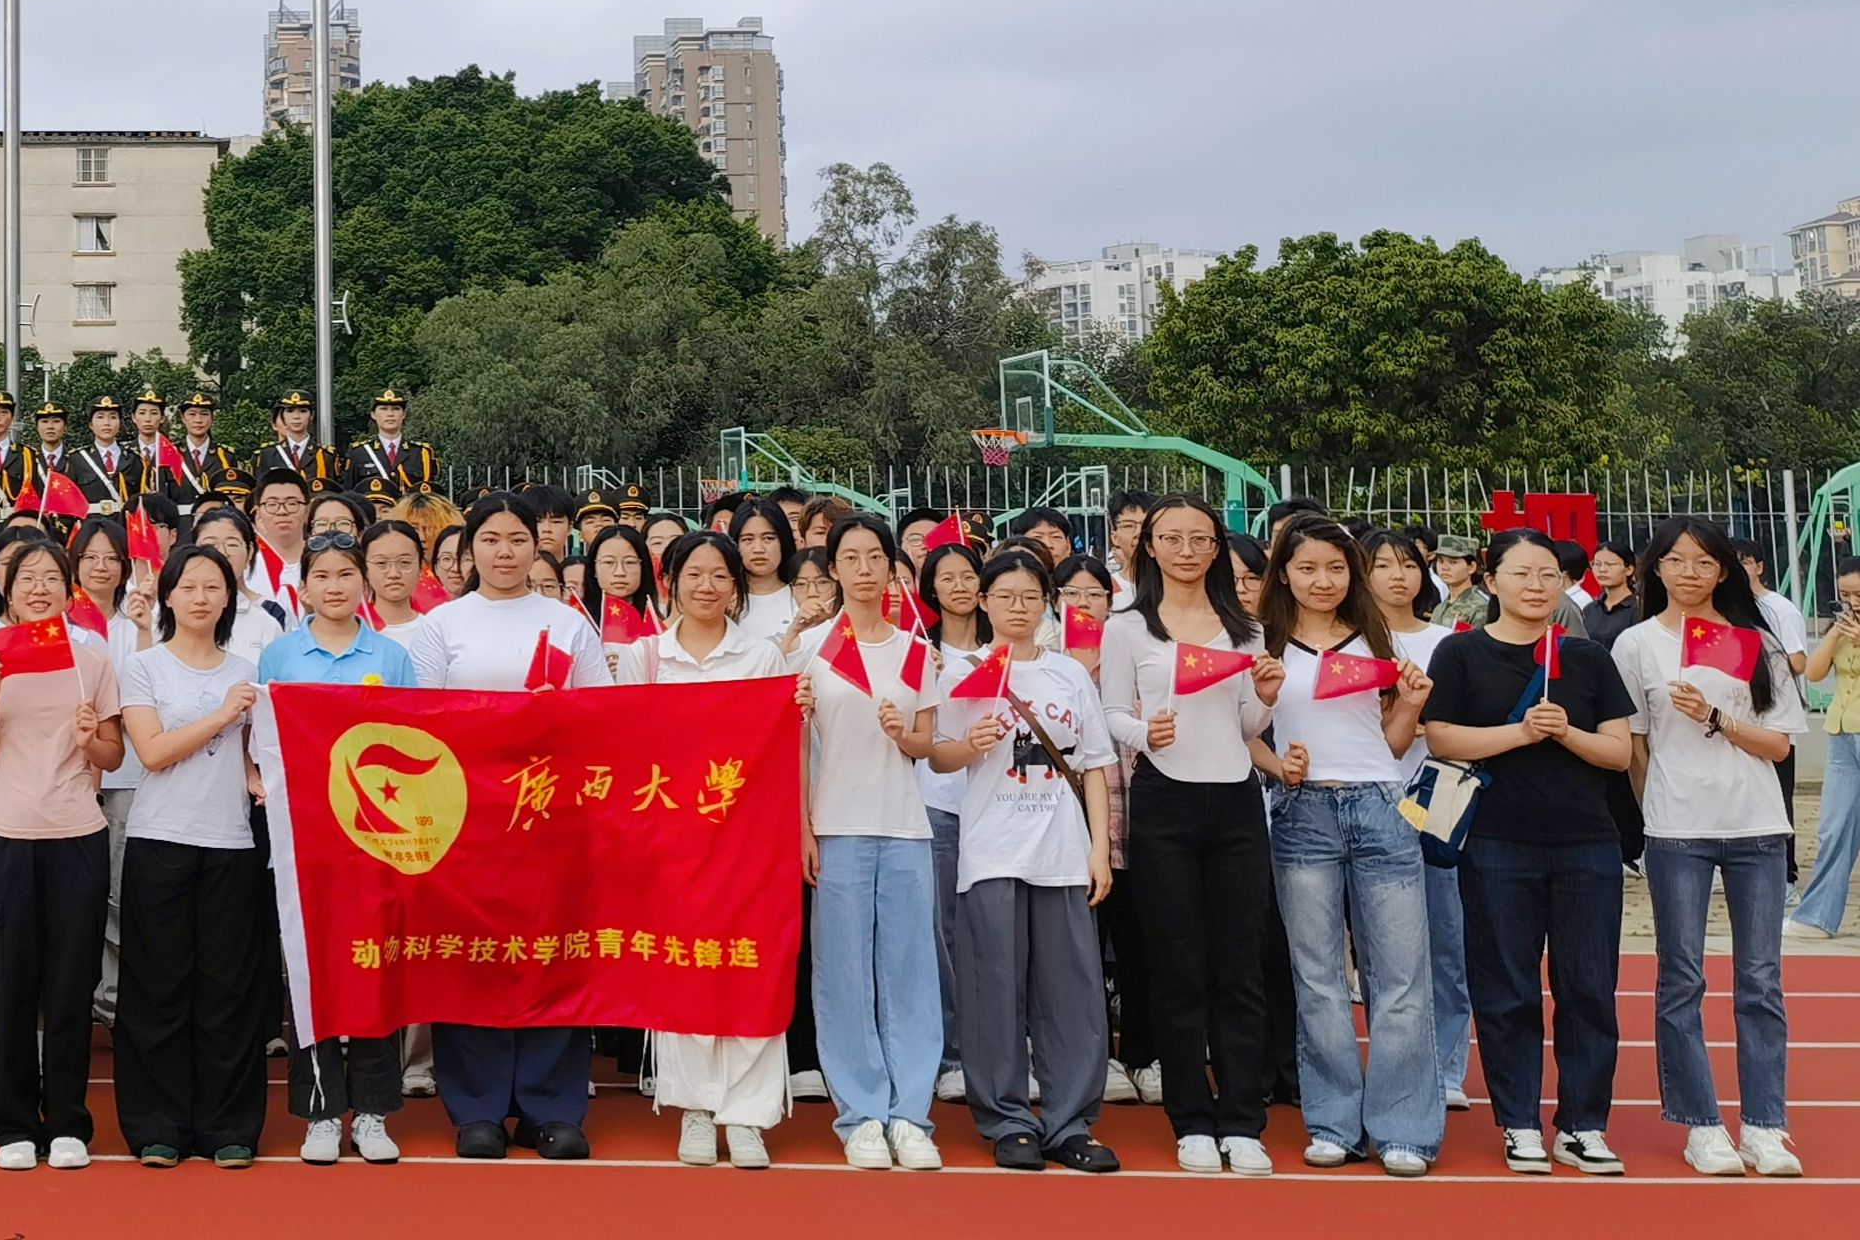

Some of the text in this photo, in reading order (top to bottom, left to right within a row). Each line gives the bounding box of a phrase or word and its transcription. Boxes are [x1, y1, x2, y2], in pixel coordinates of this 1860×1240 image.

[1045, 703, 1079, 735] CA
[996, 793, 1016, 802] YOU
[1018, 792, 1037, 802] ARE
[1039, 792, 1053, 802] MY
[1017, 804, 1038, 813] CAT
[351, 928, 760, 970] 动物科学技术学院青年先锋连
